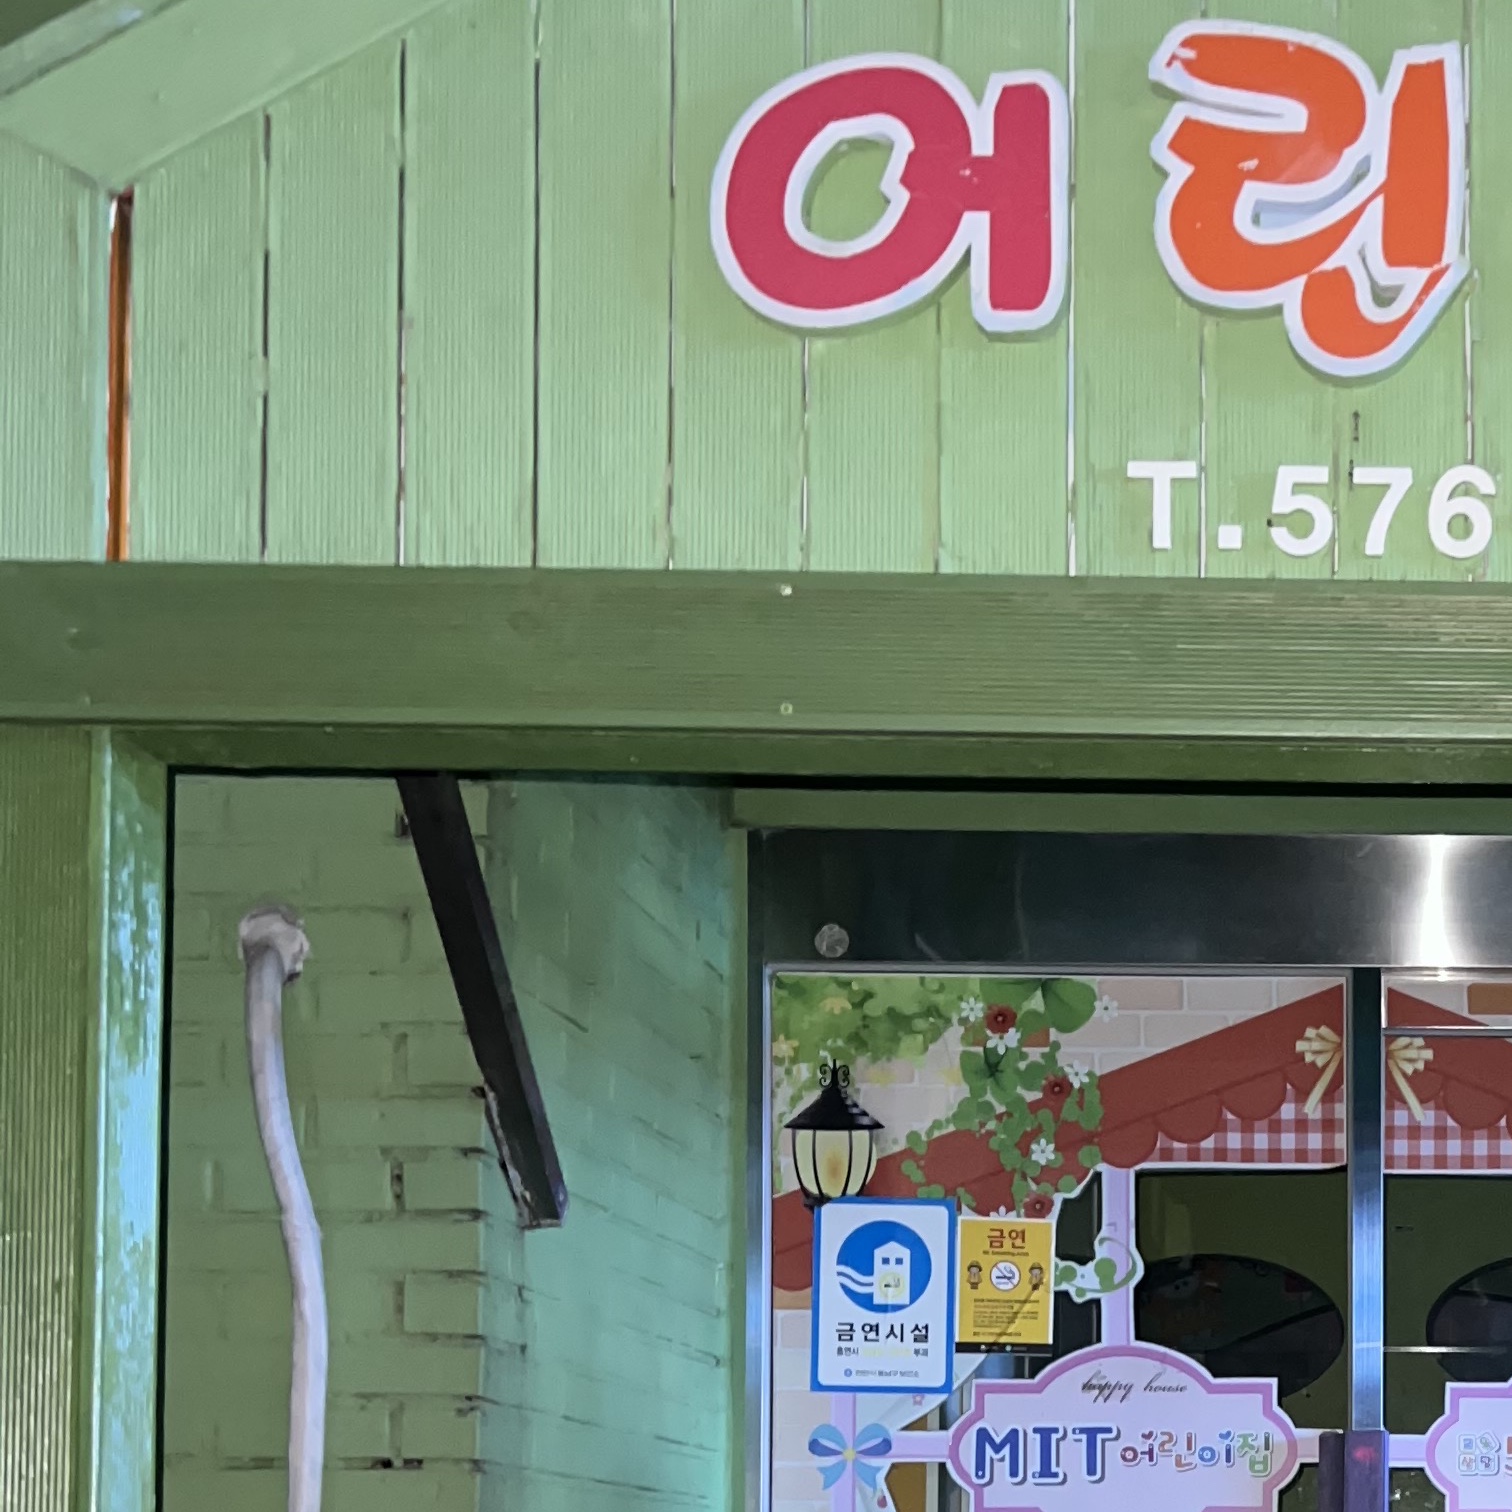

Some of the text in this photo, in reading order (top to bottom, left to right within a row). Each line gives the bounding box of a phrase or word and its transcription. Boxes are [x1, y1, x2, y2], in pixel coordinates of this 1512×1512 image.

[986, 1227, 1026, 1249] 금연
[835, 1321, 930, 1343] 금연시설
[1080, 1370, 1188, 1404] happy house
[974, 1426, 1274, 1482] MIT 어린이집
